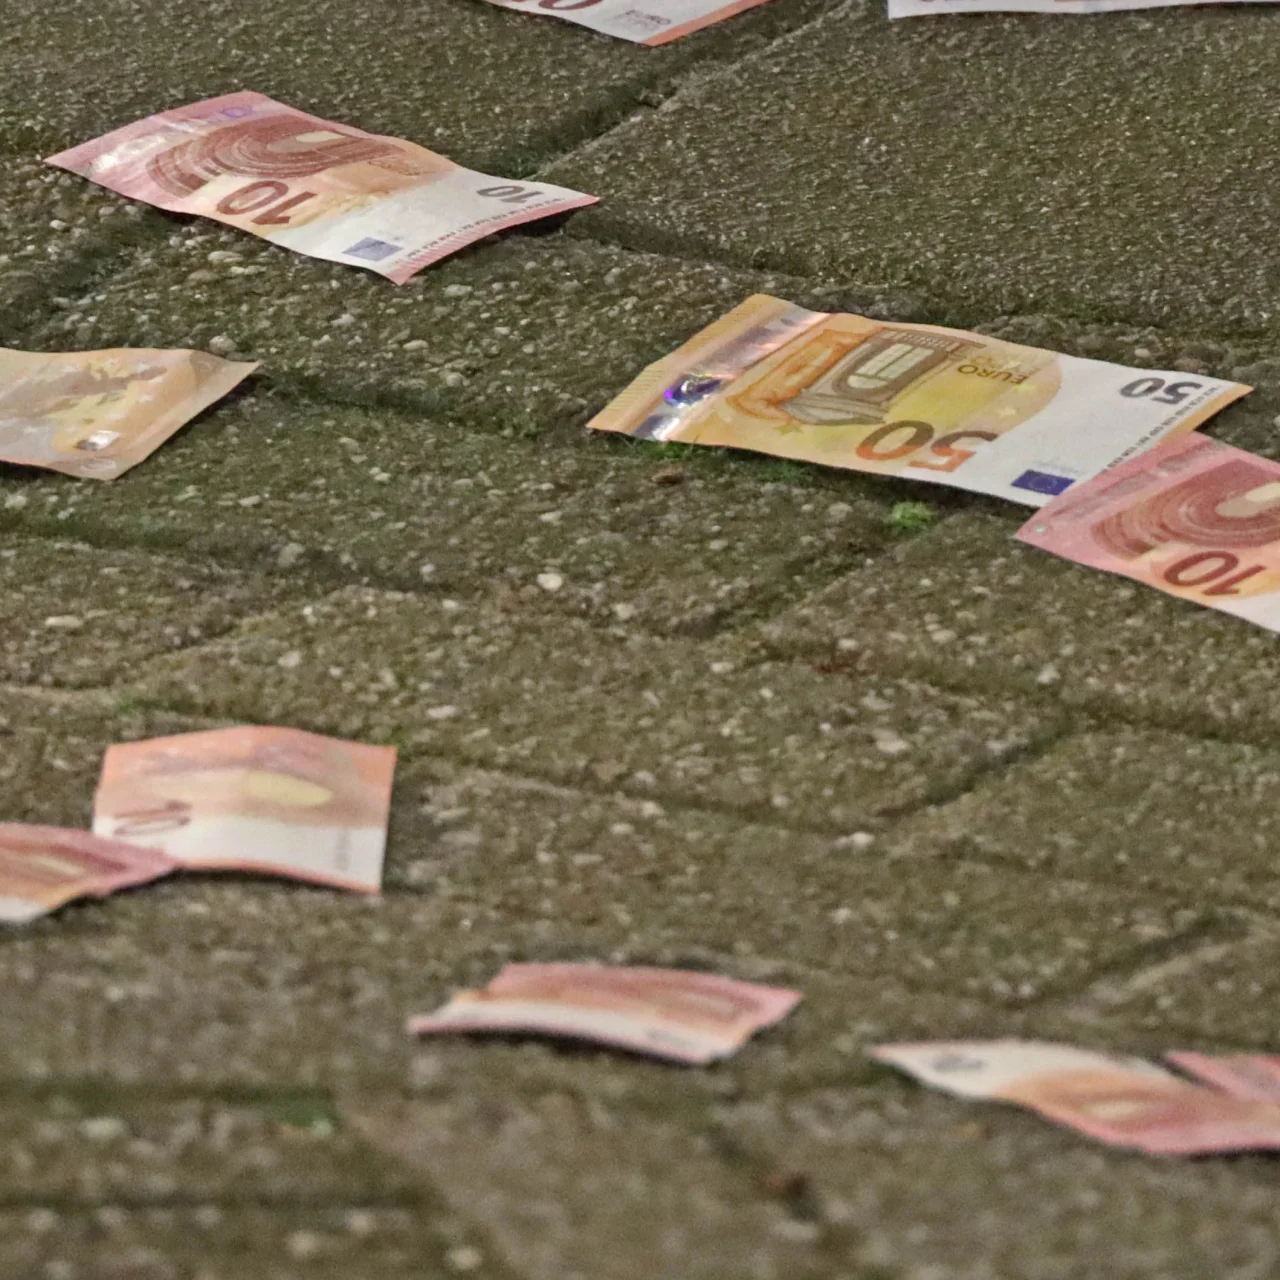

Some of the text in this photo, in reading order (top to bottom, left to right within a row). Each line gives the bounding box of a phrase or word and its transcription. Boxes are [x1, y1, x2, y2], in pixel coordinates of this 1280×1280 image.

[216, 180, 318, 226] 10
[476, 184, 545, 204] 10
[957, 364, 1029, 385] EURO
[1119, 377, 1203, 405] 50
[855, 419, 999, 473] 50
[1163, 550, 1267, 597] 10
